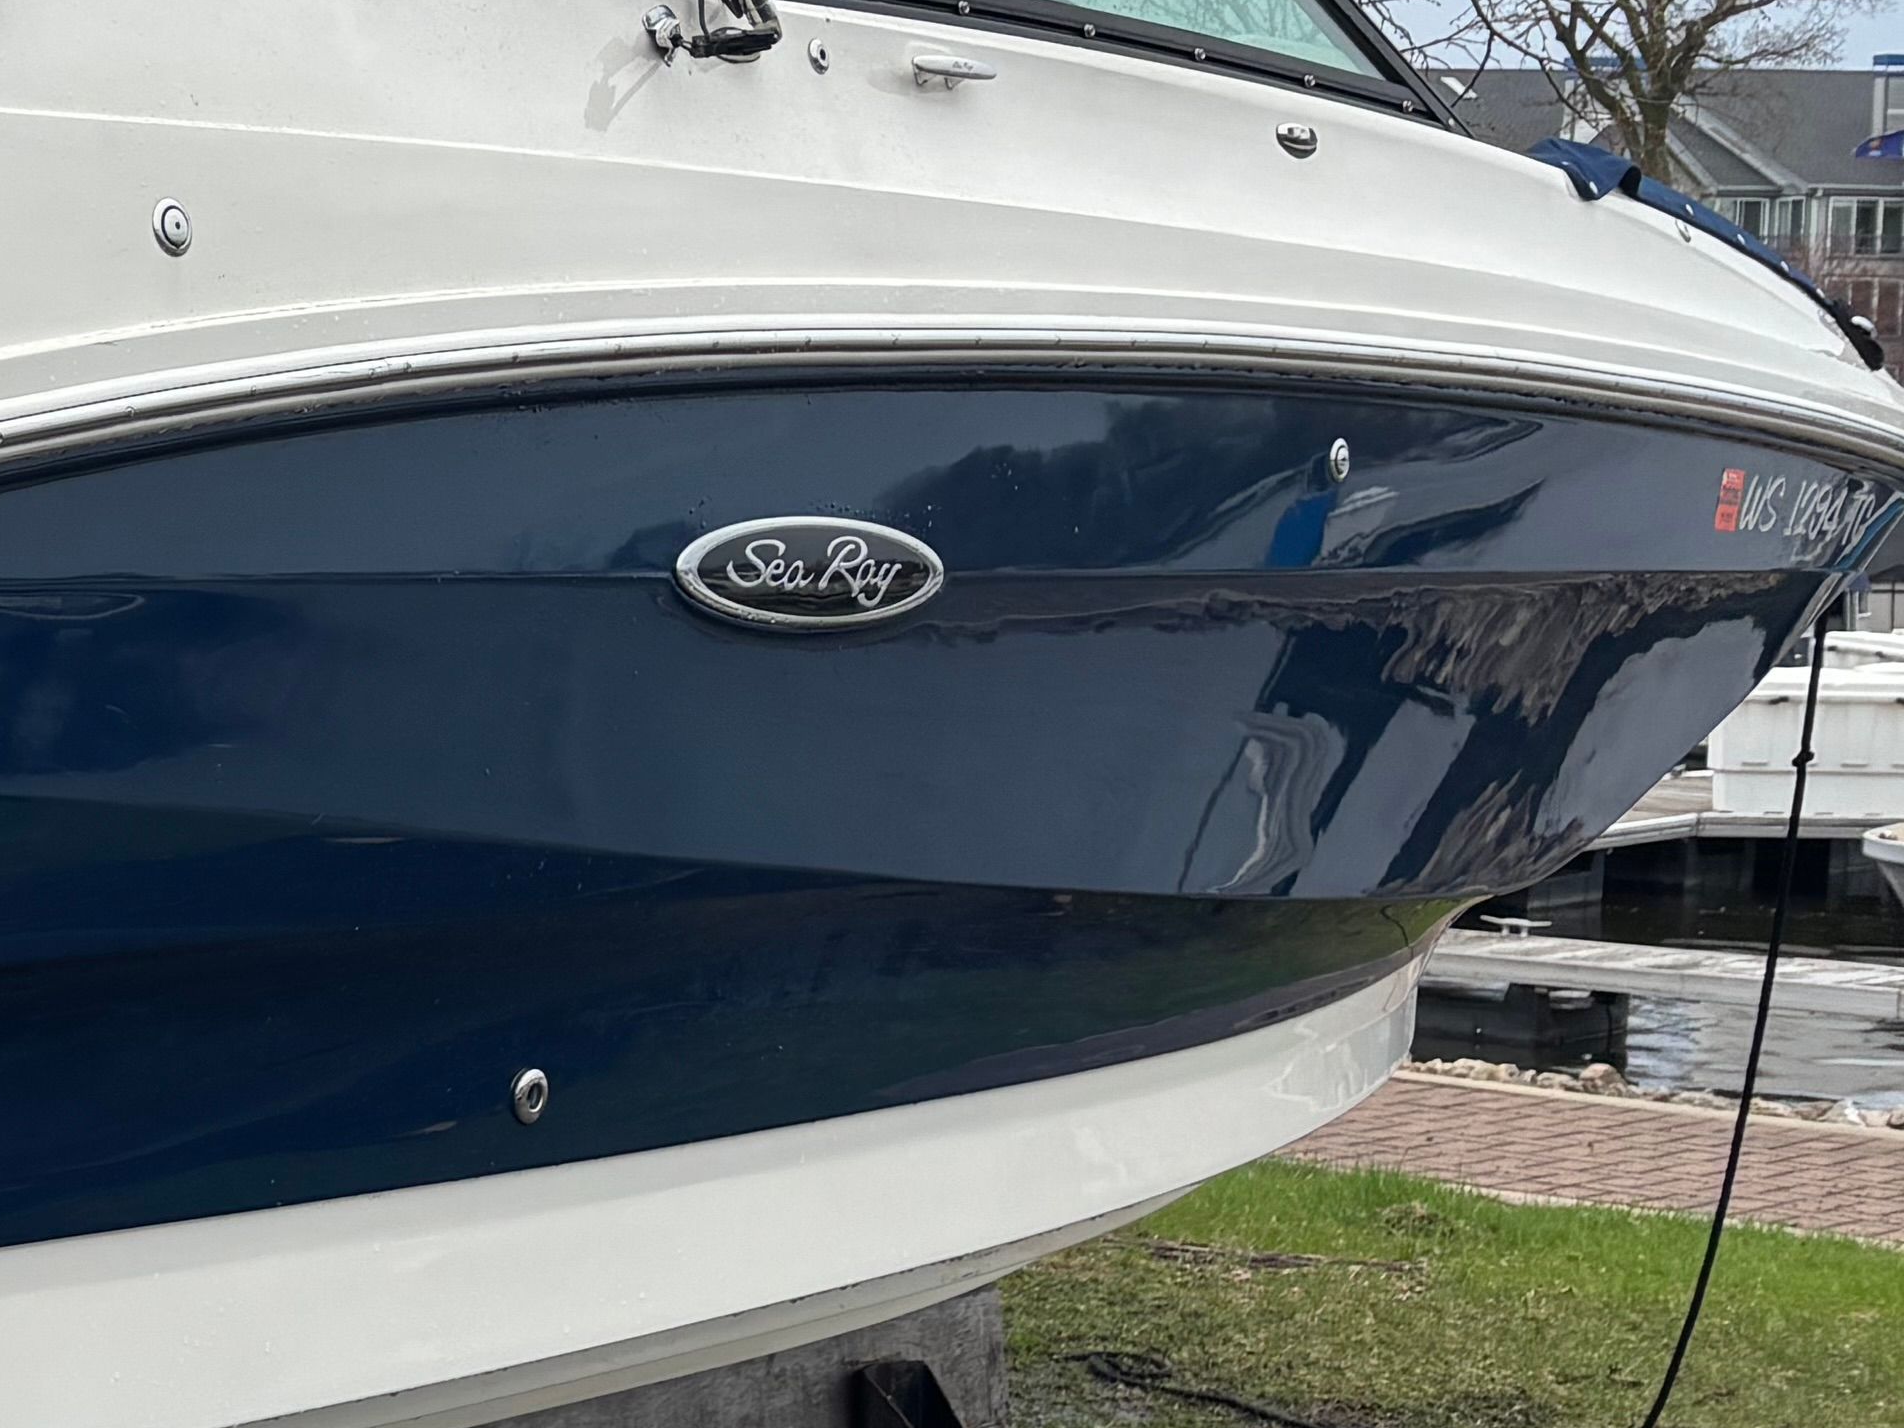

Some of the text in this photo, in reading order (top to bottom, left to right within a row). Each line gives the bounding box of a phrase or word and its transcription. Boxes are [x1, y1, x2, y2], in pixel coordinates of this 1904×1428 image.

[1738, 474, 1786, 533] WS
[726, 535, 903, 608] Sea Ray
